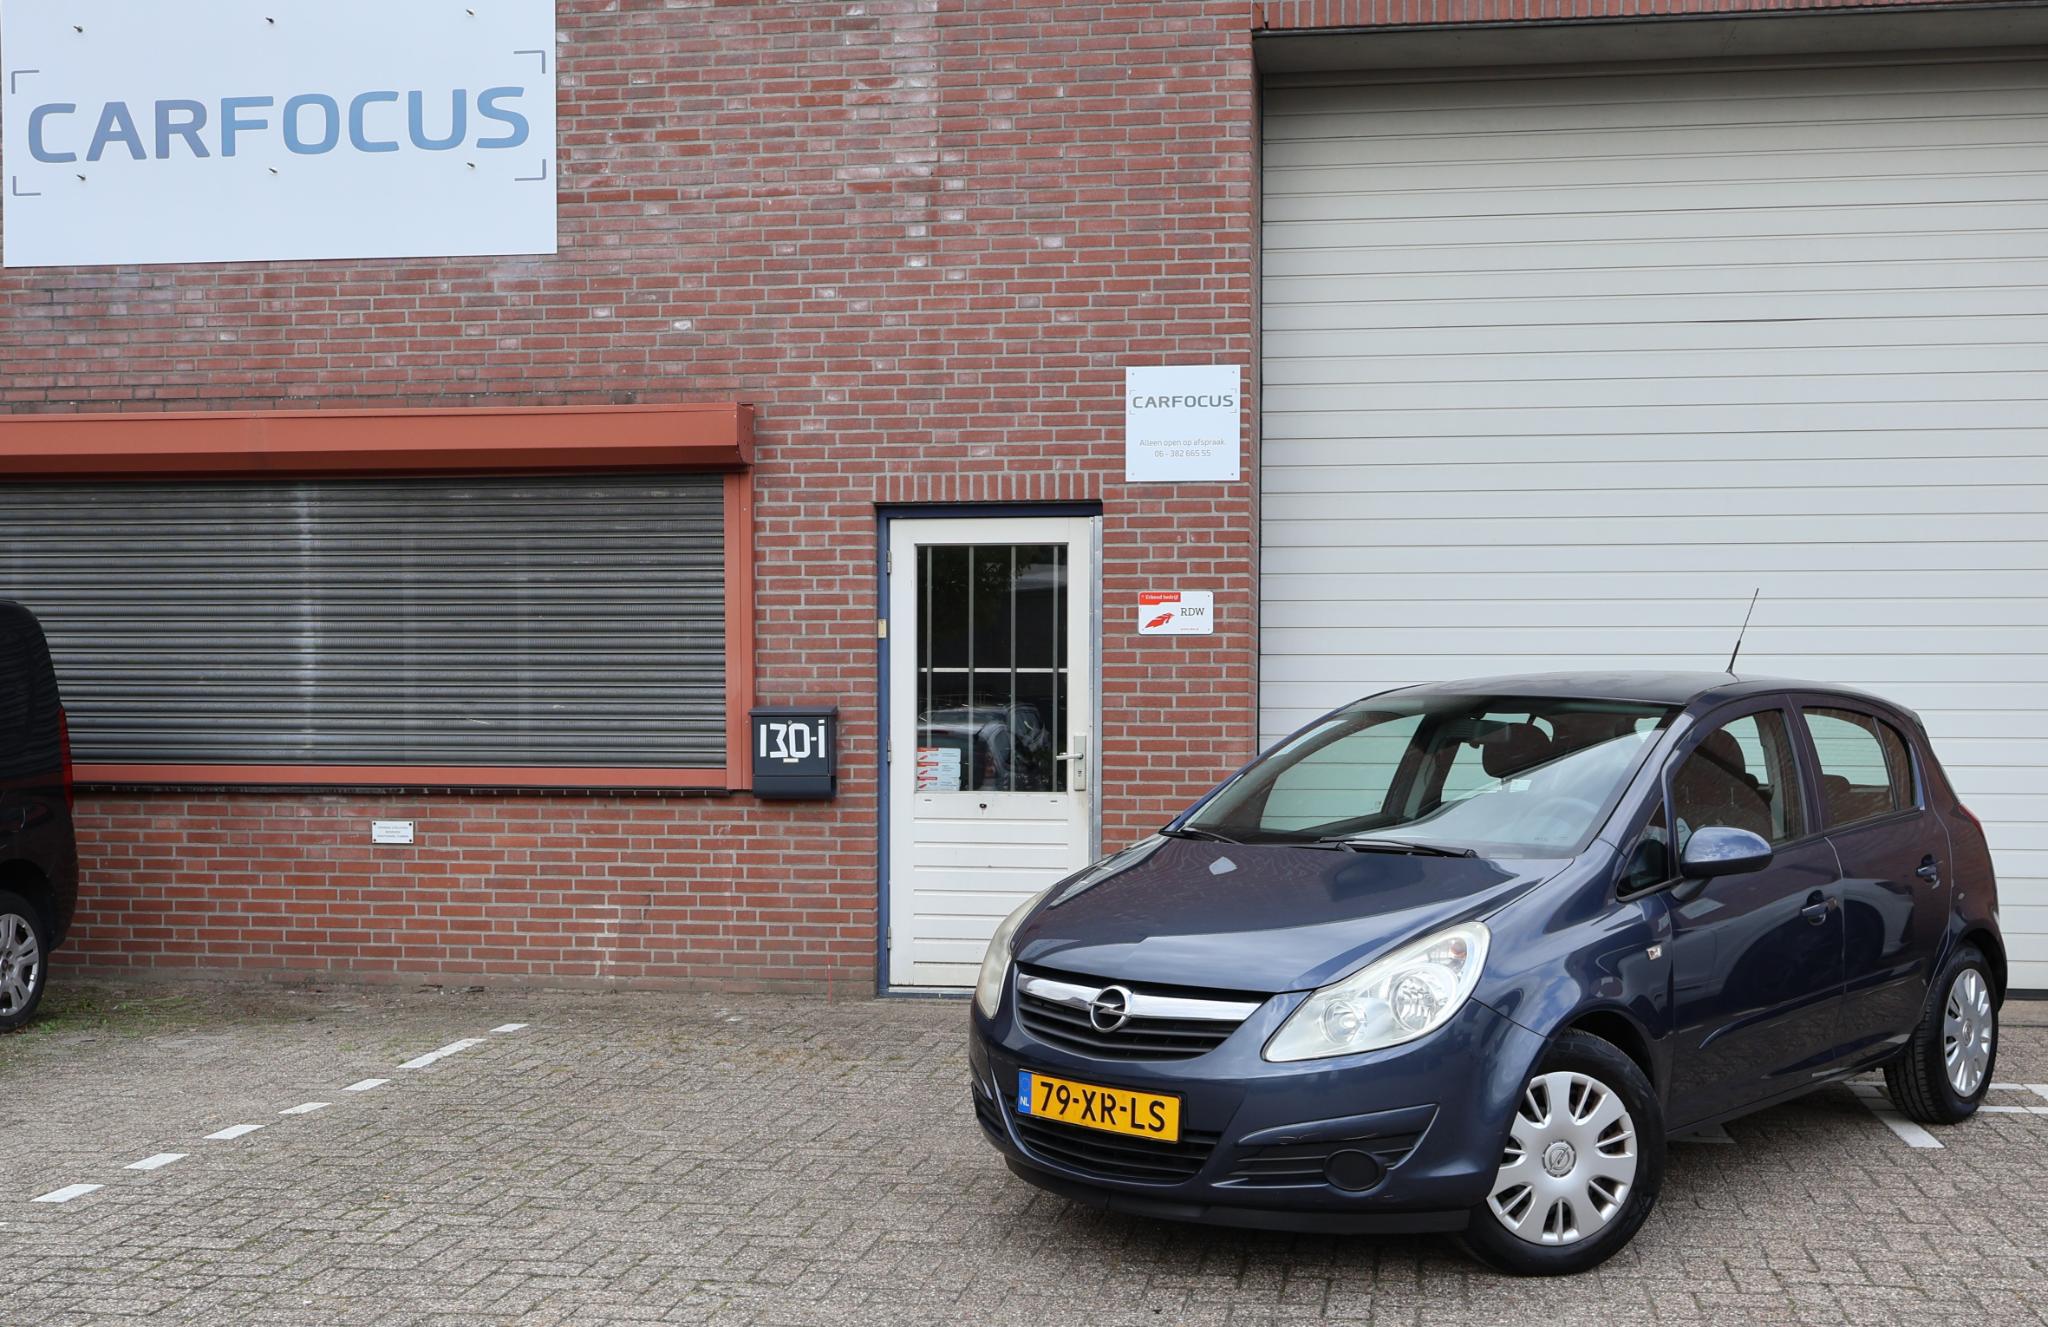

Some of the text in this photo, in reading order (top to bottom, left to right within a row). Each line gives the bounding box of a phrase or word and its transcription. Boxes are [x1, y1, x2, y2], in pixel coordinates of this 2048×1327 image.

[28, 86, 530, 164] CARFOCUS
[1132, 394, 1234, 408] CARFOCUS
[1139, 439, 1162, 447] Alleen
[1163, 440, 1181, 448] open
[1154, 450, 1164, 458] 06
[1180, 607, 1205, 617] RDW
[1020, 1081, 1166, 1133] NL 79-XR-LS
